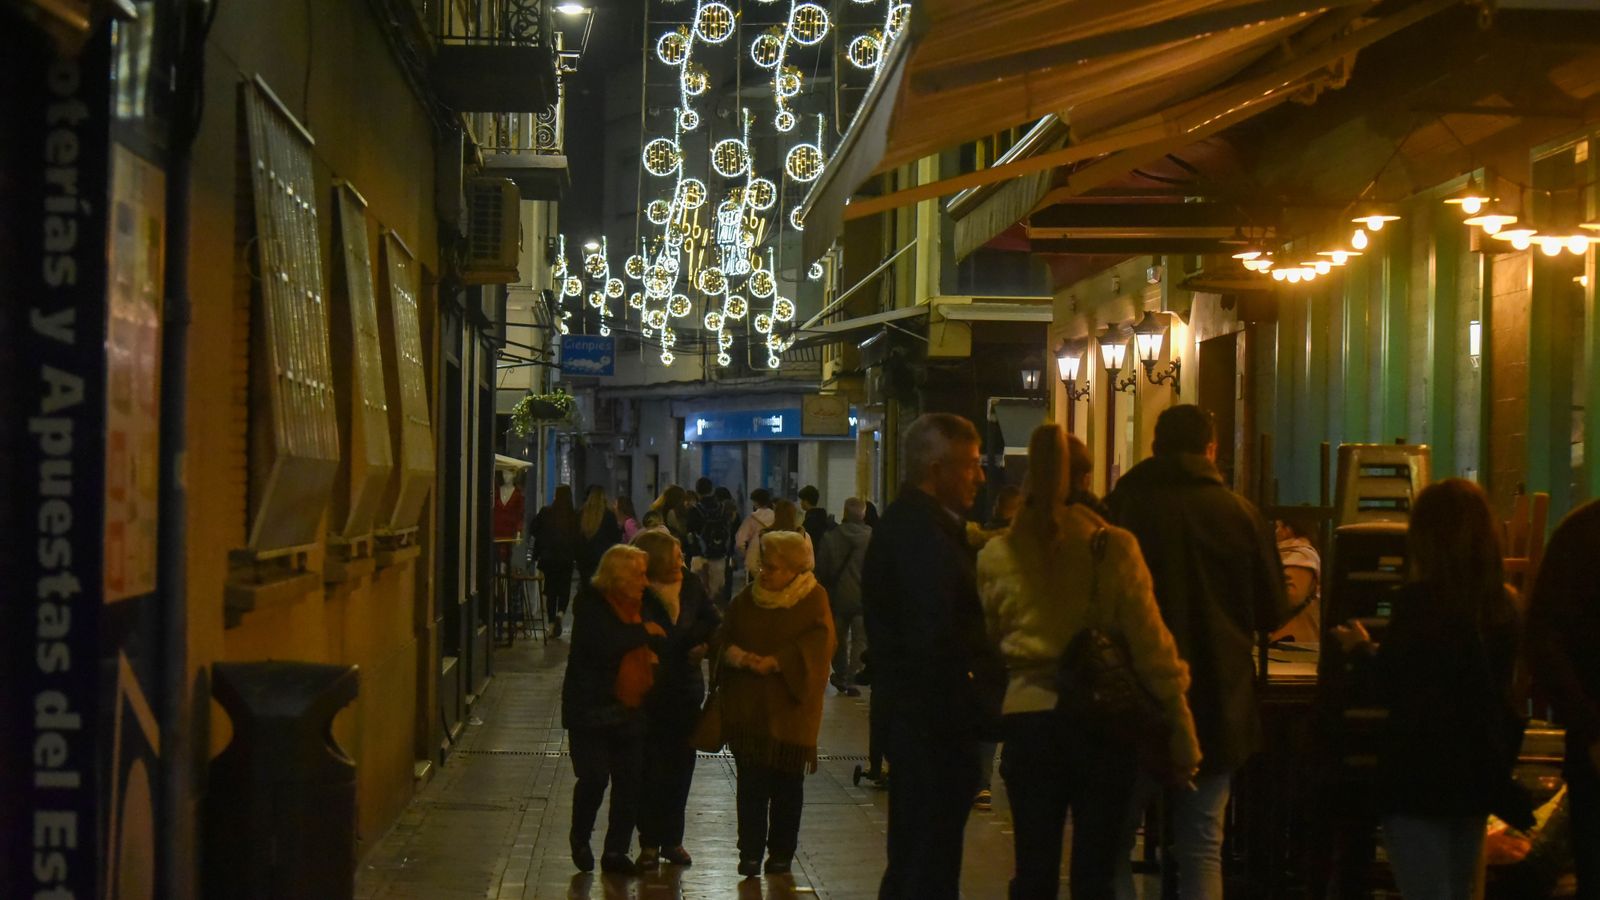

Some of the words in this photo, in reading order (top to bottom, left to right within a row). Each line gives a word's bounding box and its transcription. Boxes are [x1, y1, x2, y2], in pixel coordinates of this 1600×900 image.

[43, 61, 92, 287] oterías
[30, 307, 76, 345] y
[28, 364, 85, 673] Apuestas
[33, 689, 82, 789] del
